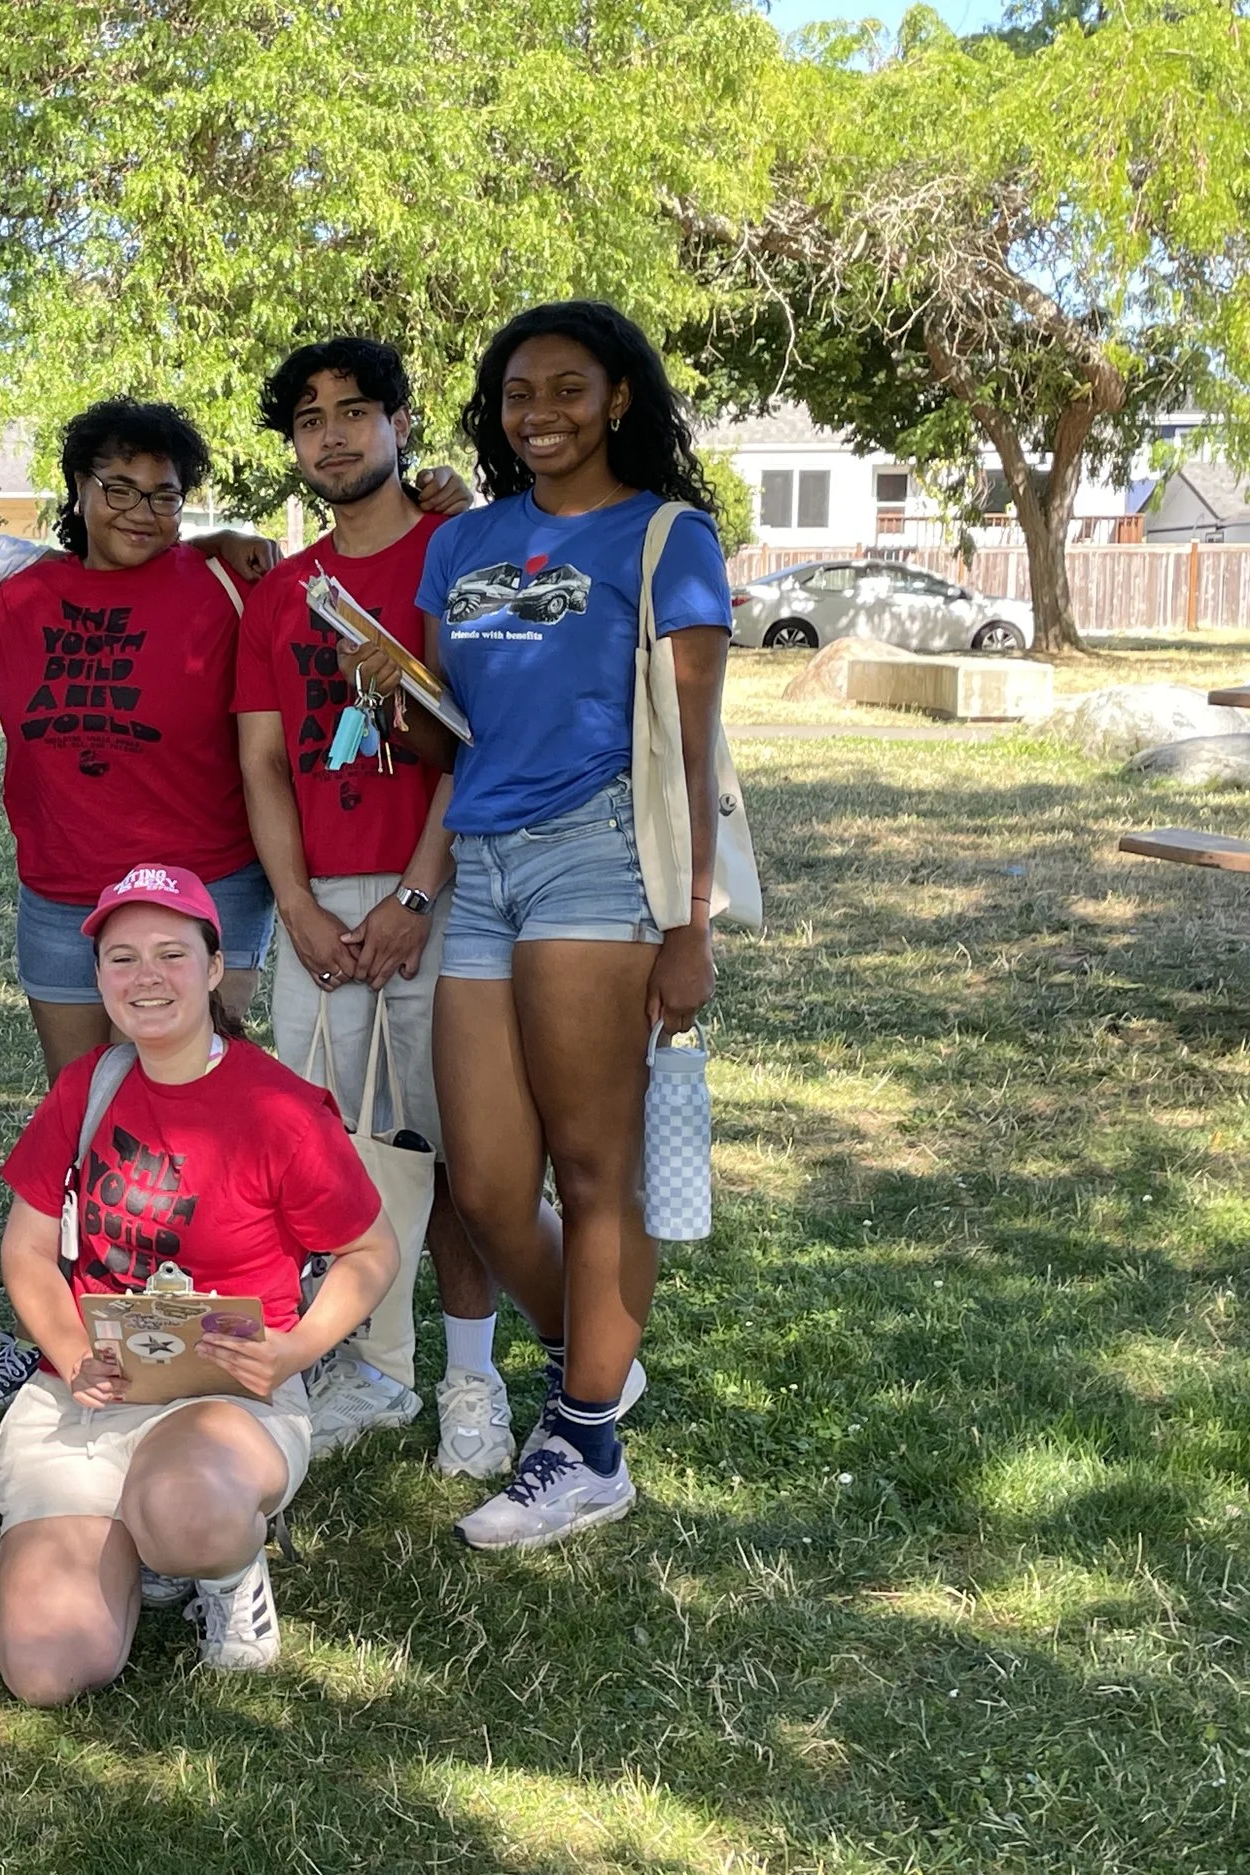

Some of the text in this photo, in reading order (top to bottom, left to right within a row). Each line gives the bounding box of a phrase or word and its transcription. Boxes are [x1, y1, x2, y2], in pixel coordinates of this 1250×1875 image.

[61, 599, 133, 634] THE
[42, 626, 148, 656] YOUTH
[451, 630, 543, 641] friends with benefits
[26, 685, 143, 713] A NEW
[20, 713, 163, 743] WORLD
[112, 1125, 188, 1191] THE
[87, 1148, 200, 1227] YOUTH
